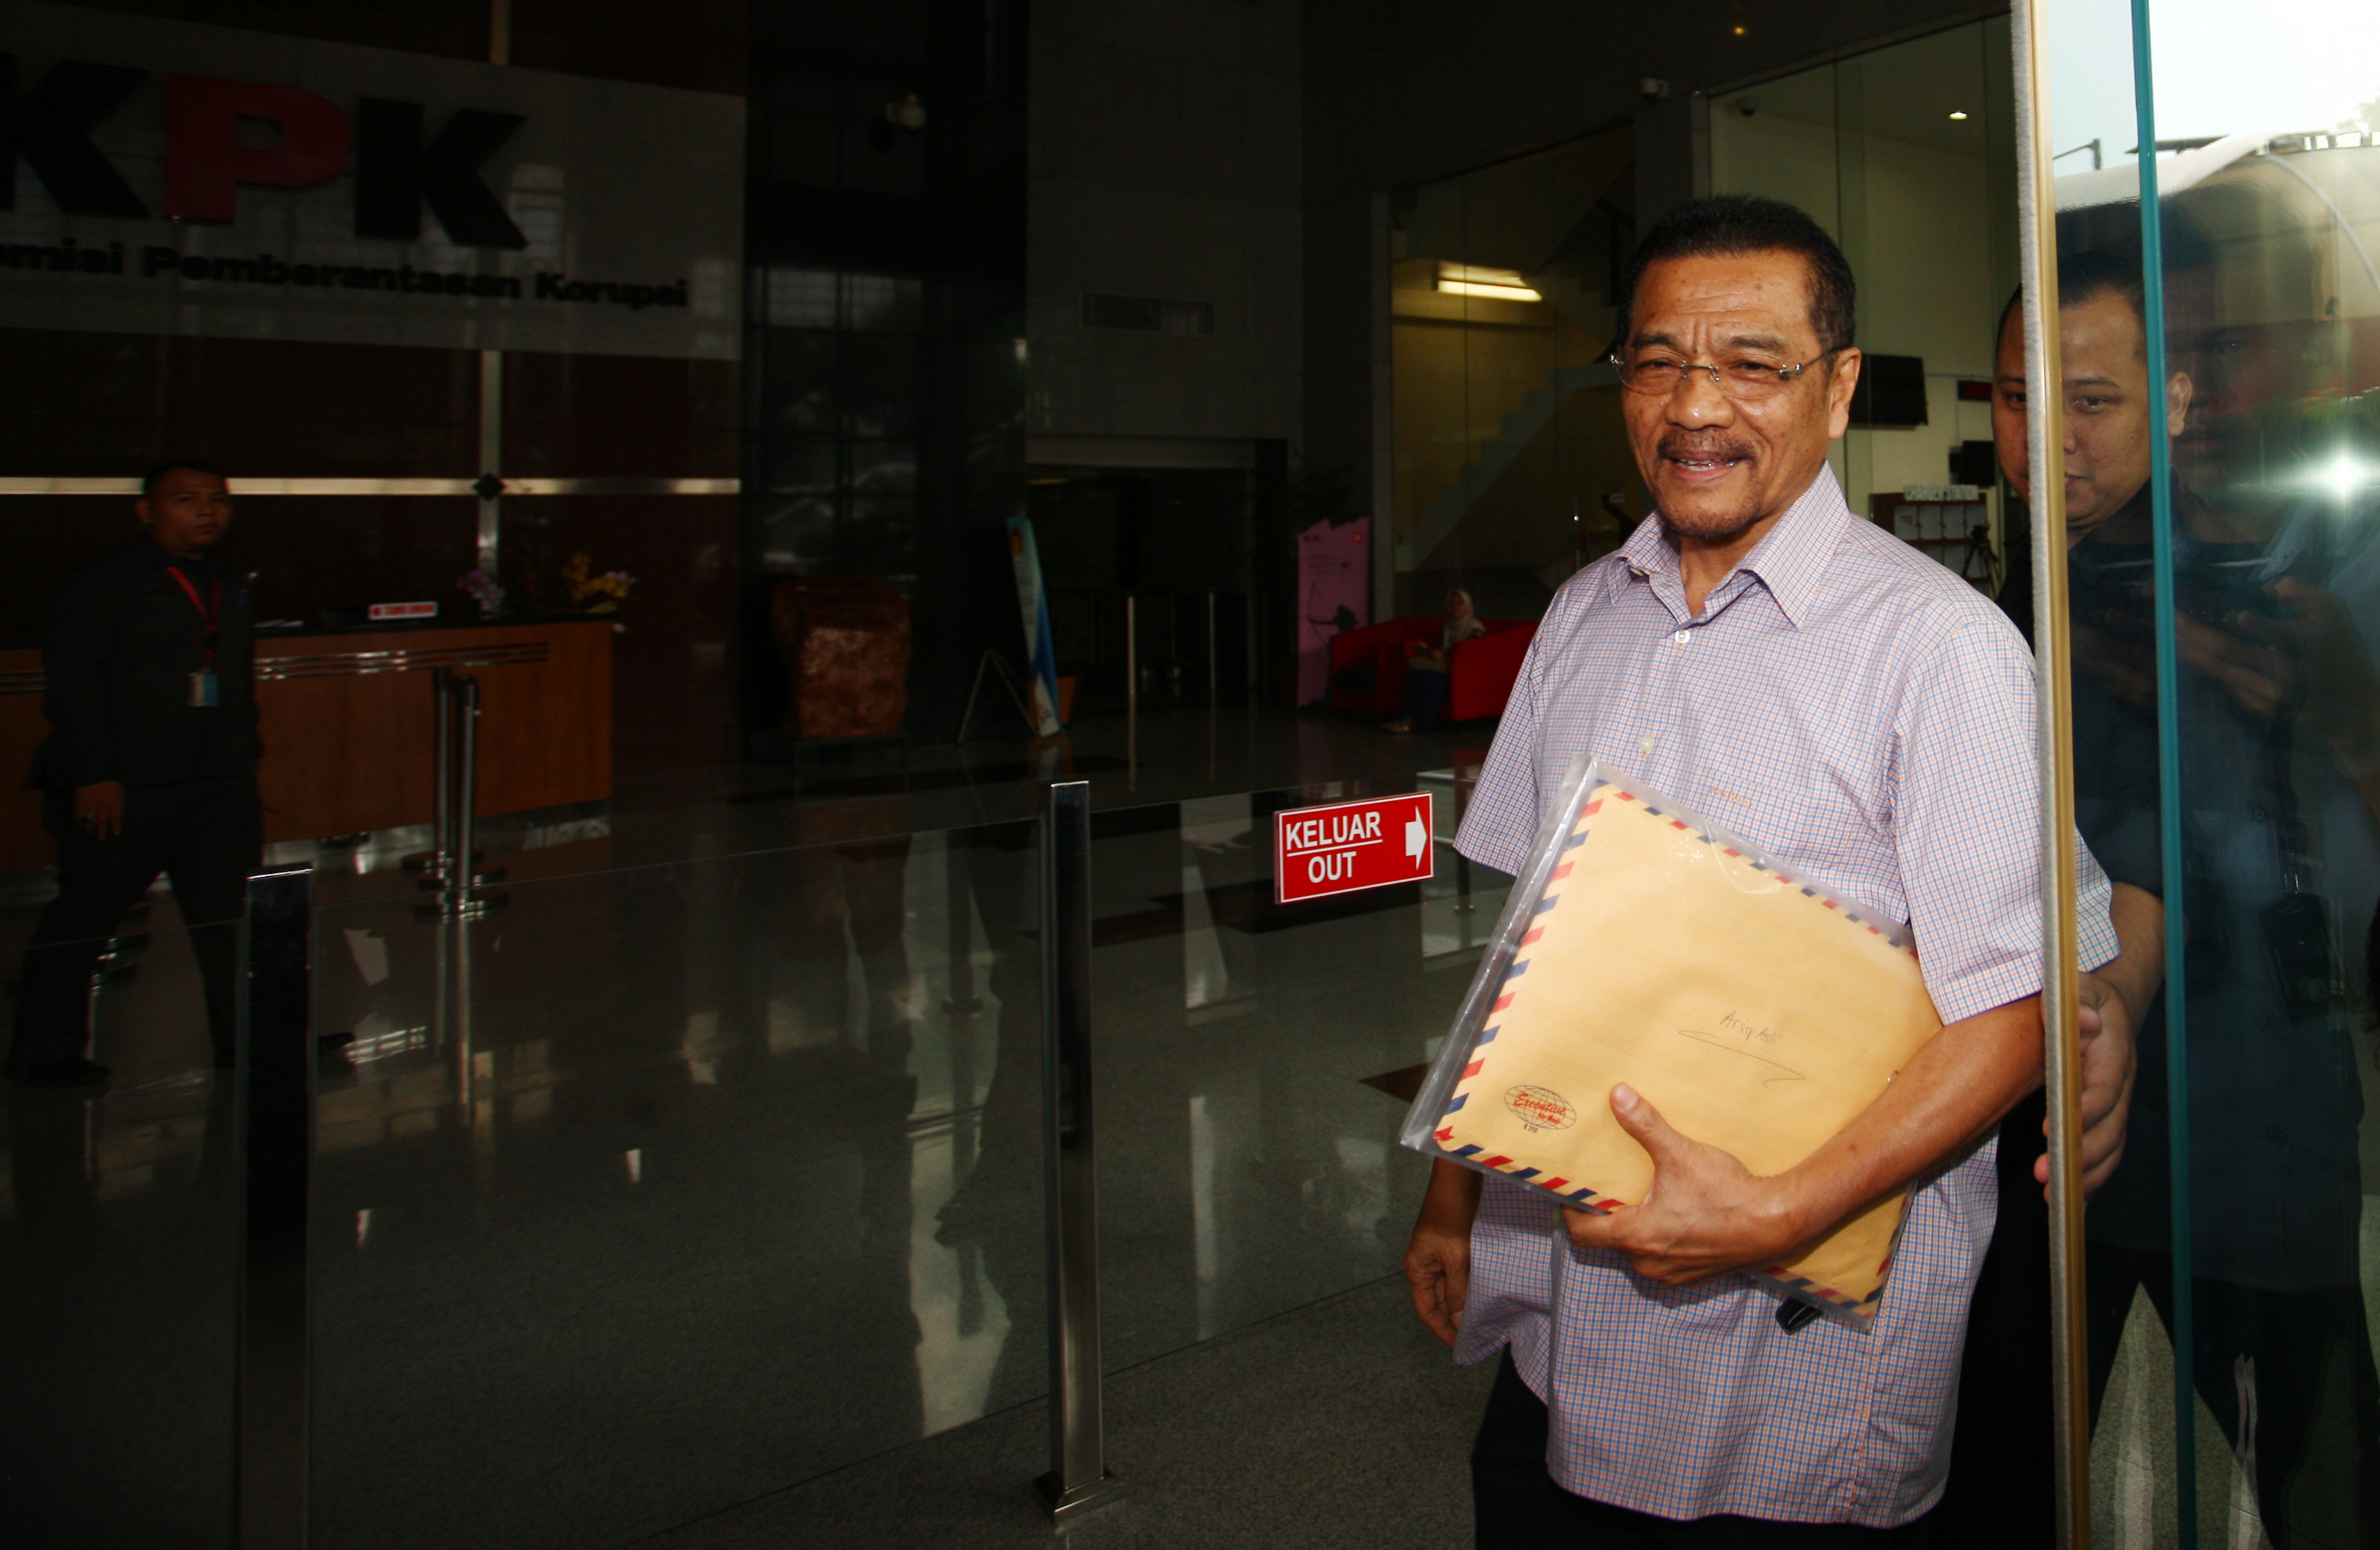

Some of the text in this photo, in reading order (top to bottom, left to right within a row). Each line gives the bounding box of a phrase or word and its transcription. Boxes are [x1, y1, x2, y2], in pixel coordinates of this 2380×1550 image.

[0, 52, 529, 249] KPK
[143, 246, 521, 298] Pemberantasan
[536, 272, 687, 311] Korupsi
[1285, 811, 1382, 851] KELUAR
[1307, 851, 1358, 884] OUT
